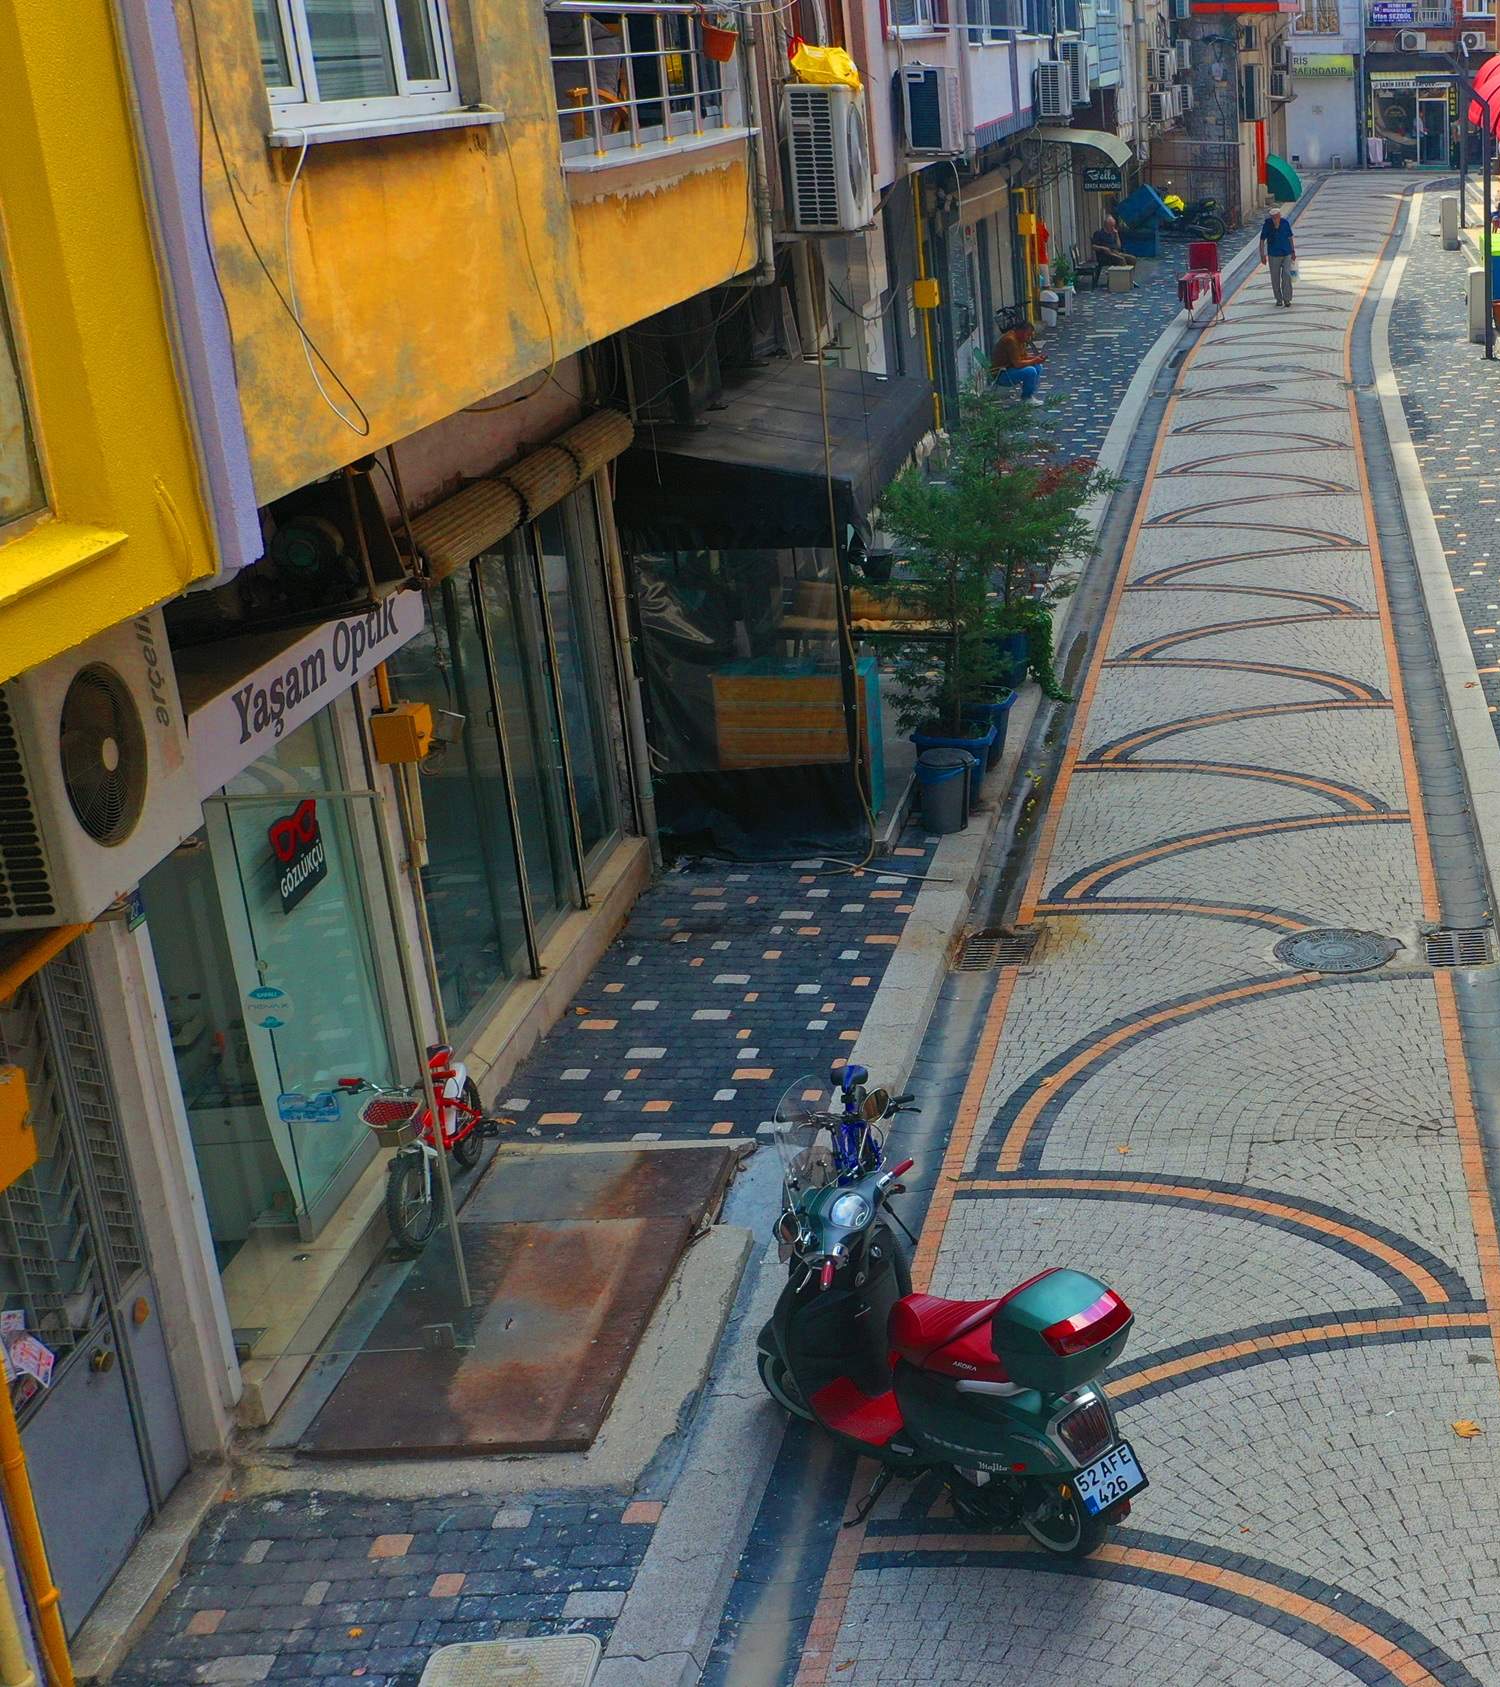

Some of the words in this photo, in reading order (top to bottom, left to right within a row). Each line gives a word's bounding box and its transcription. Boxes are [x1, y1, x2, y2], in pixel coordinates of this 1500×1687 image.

[232, 648, 327, 744] Yaşam
[333, 597, 399, 676] Optik
[280, 839, 324, 898] GÖZLÜKÇÜ
[1076, 1469, 1100, 1492] 52
[1100, 1446, 1132, 1478] AFE
[1098, 1475, 1128, 1503] 426
